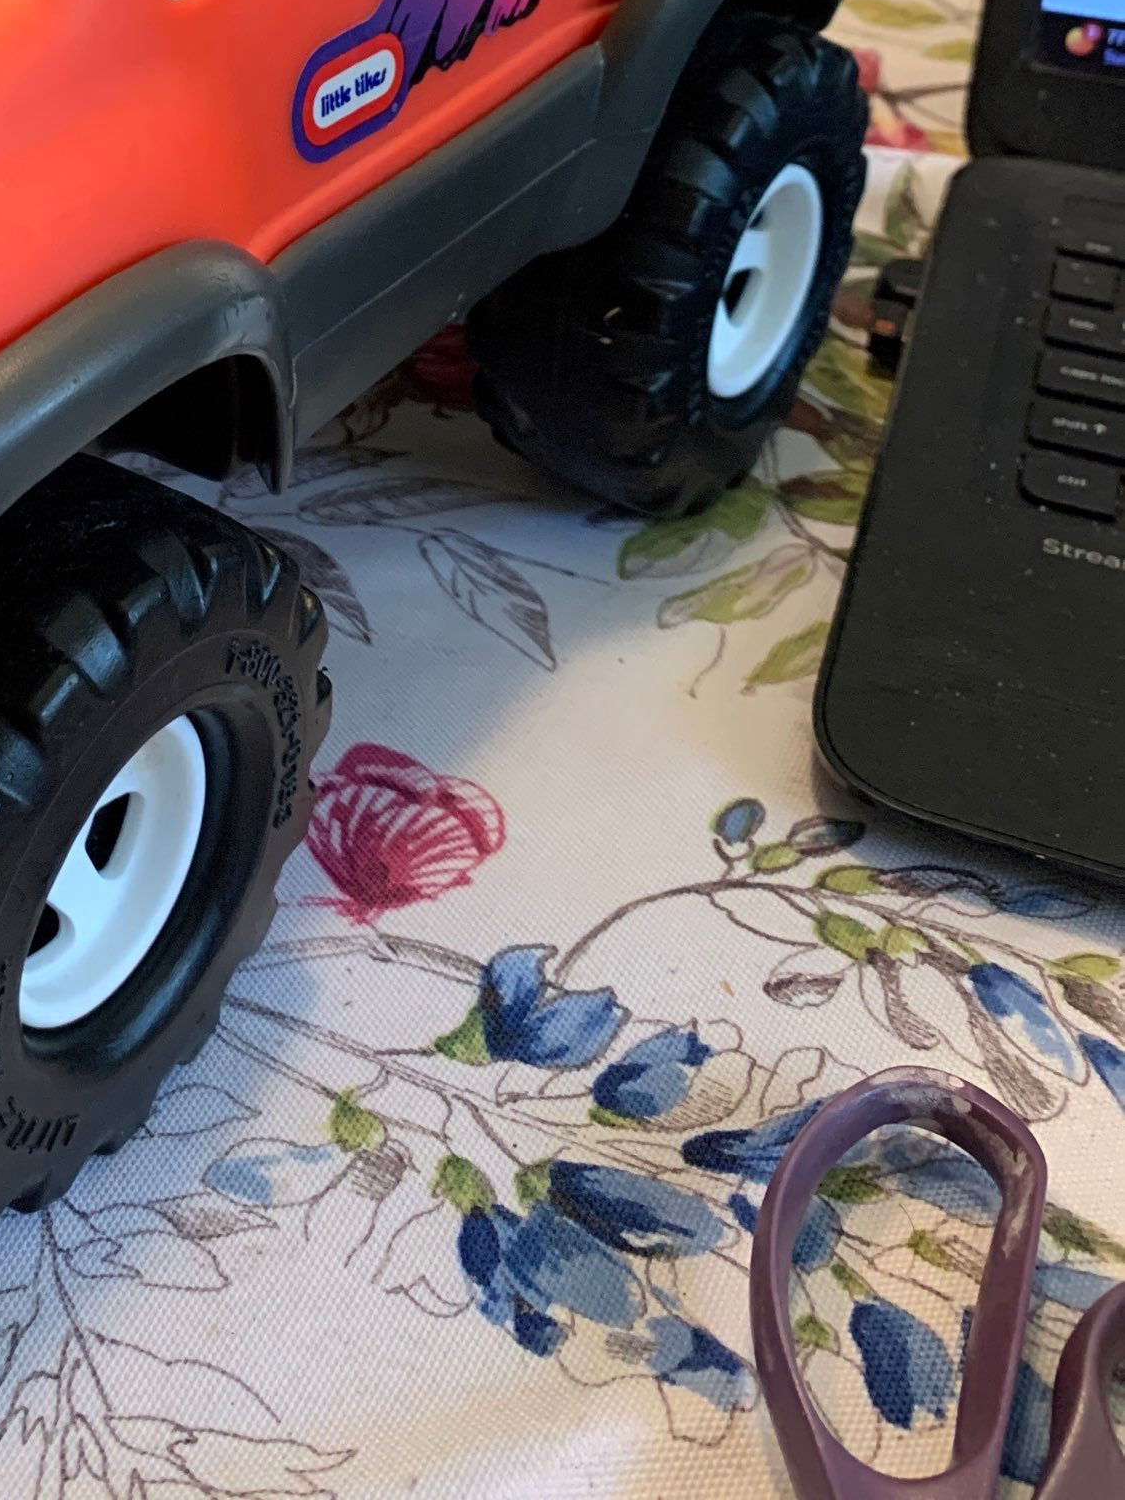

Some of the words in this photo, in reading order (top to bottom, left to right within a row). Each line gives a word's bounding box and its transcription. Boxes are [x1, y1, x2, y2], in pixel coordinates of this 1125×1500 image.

[321, 85, 352, 118] little
[354, 67, 387, 97] tikes
[1042, 537, 1125, 572] Strea
